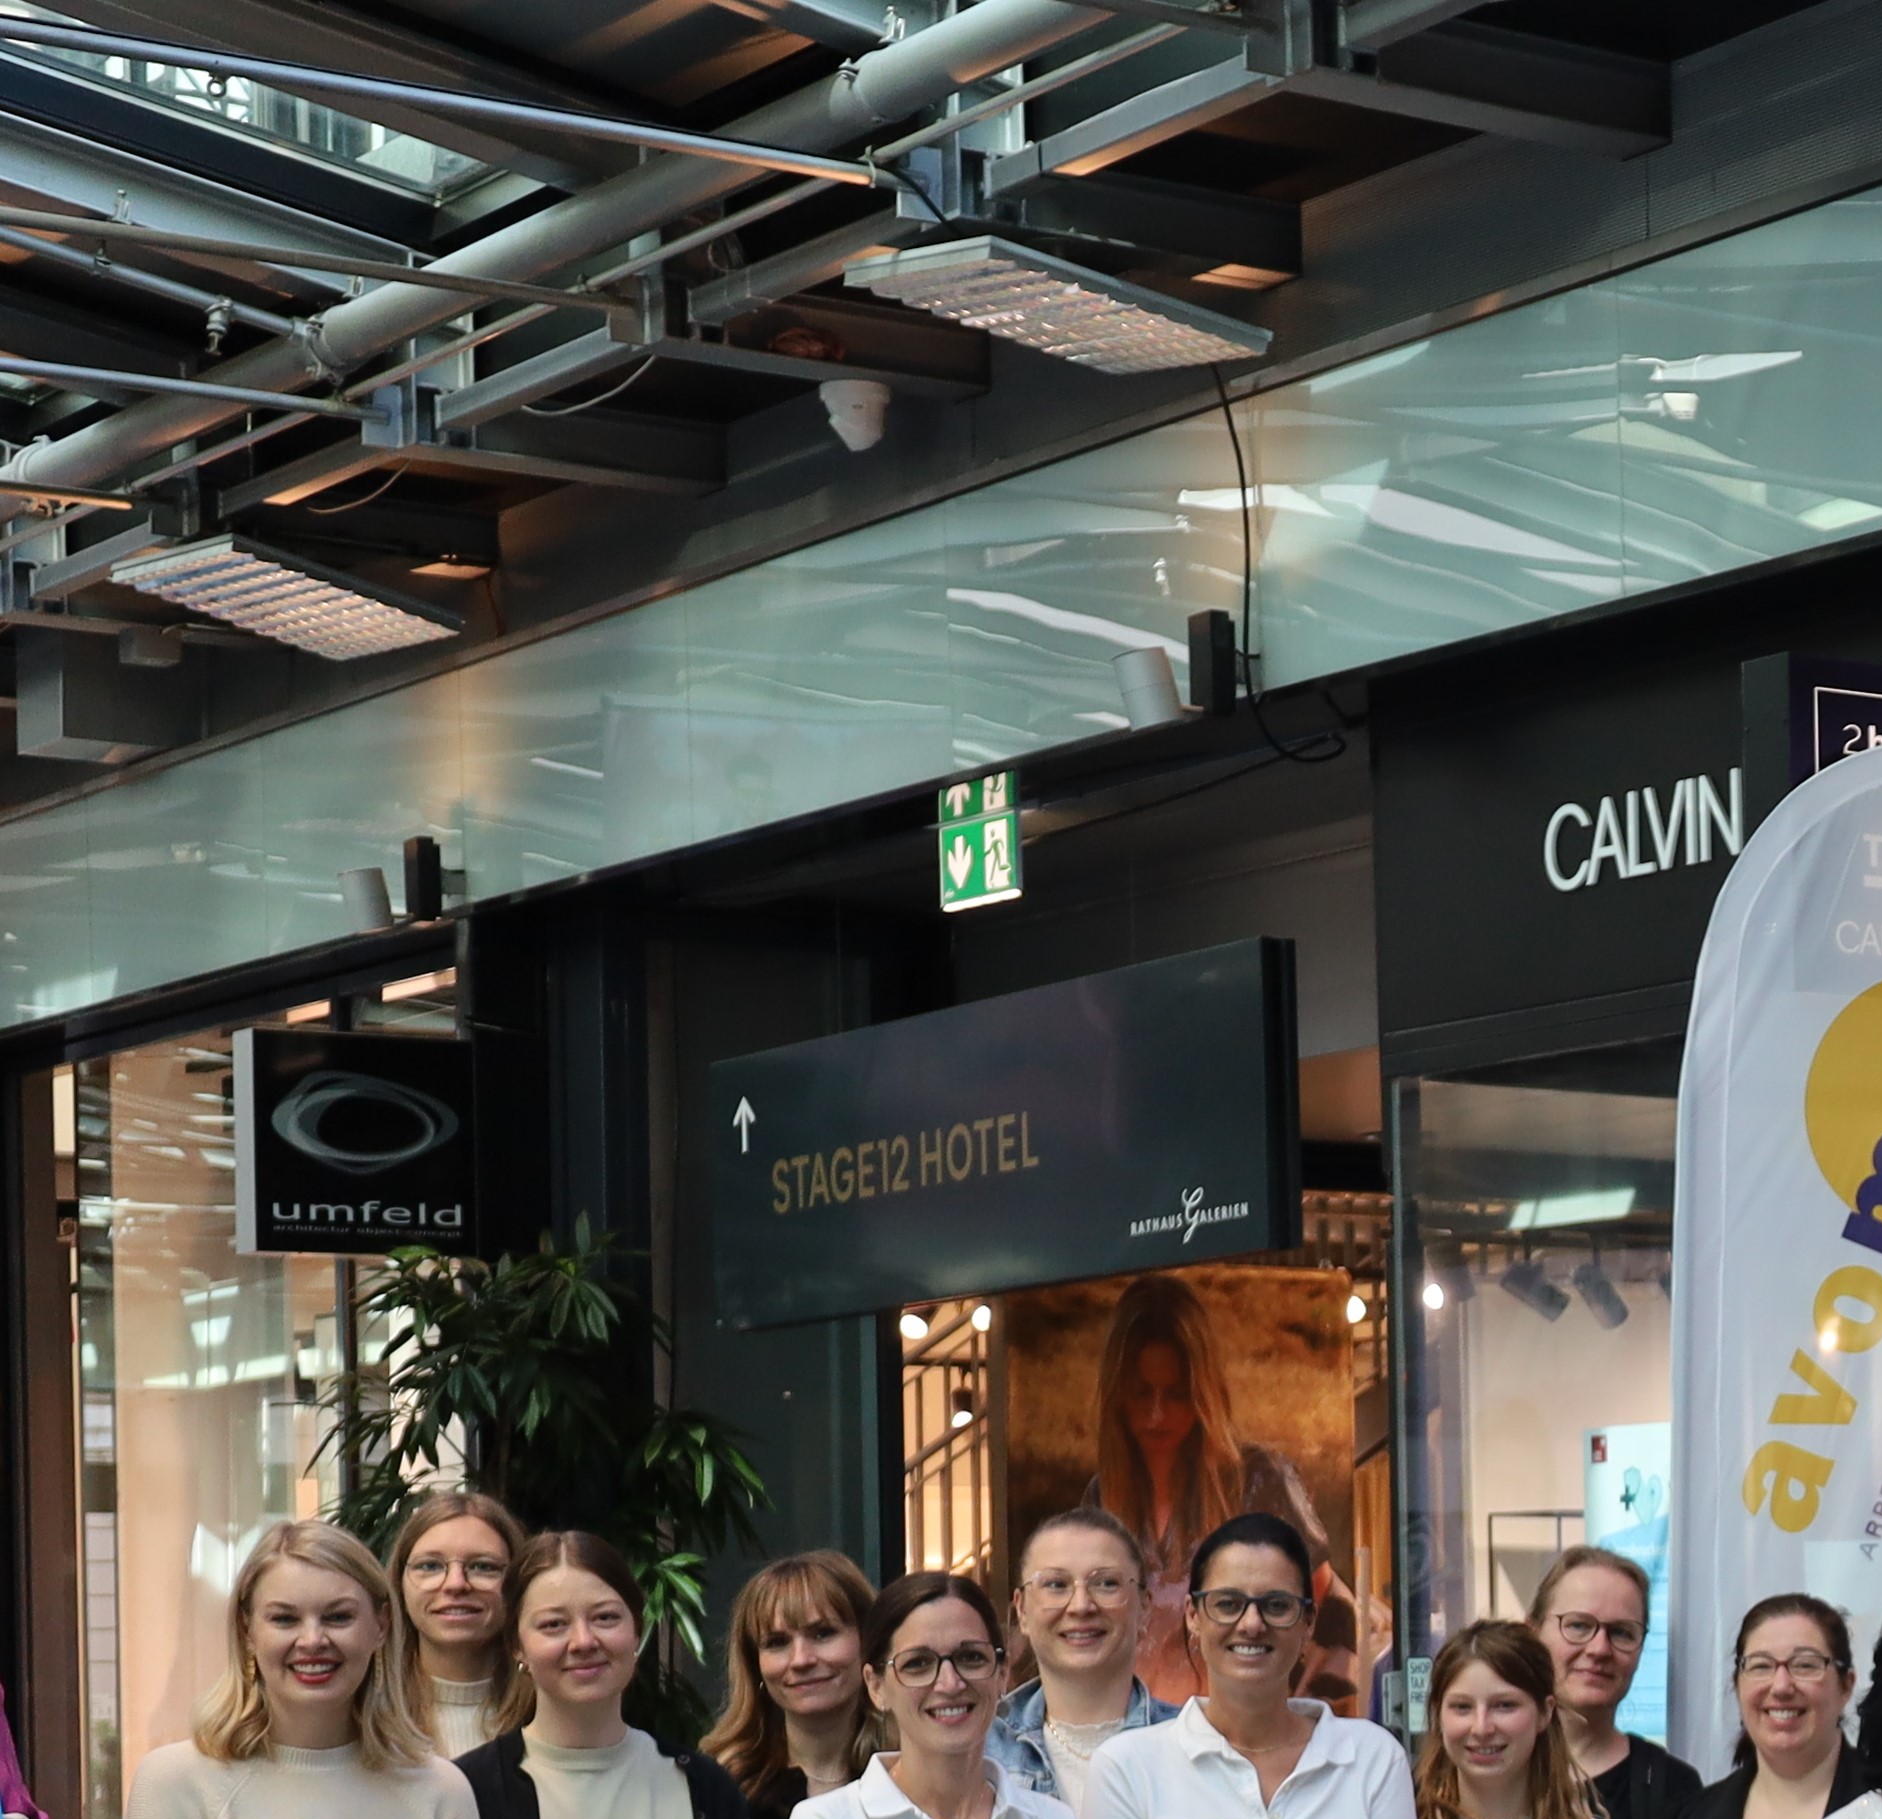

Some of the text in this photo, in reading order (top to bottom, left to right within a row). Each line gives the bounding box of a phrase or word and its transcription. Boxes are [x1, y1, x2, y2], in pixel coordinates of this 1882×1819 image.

[1543, 767, 1743, 892] CALVIN
[271, 1200, 462, 1227] umfeld
[771, 1111, 1040, 1215] STAGE12 HOTEL
